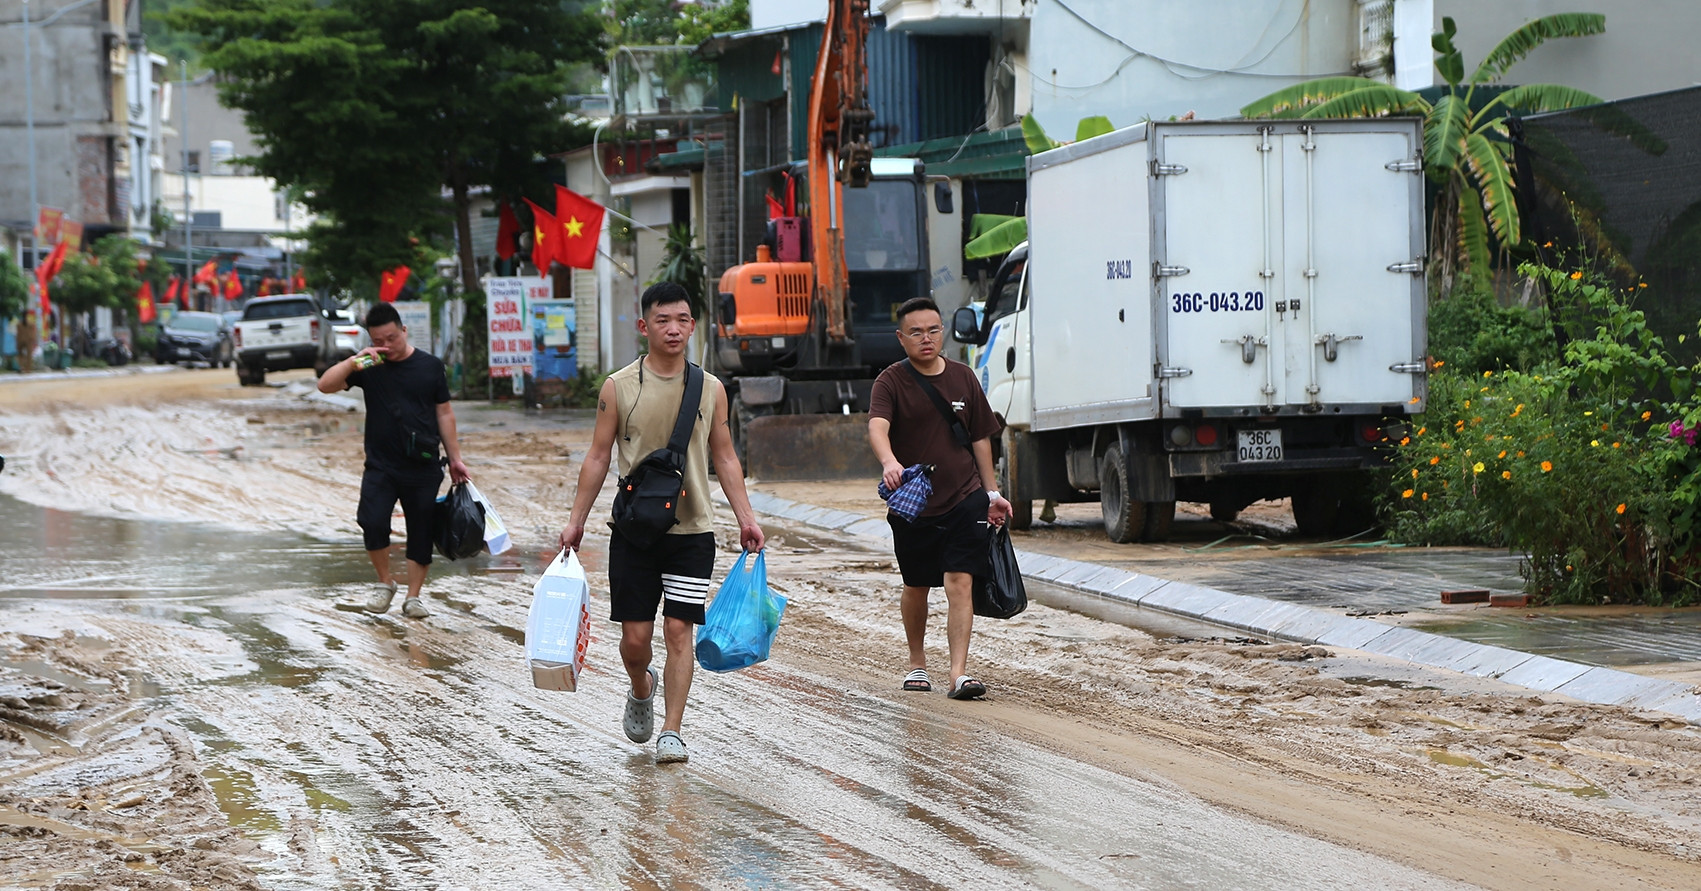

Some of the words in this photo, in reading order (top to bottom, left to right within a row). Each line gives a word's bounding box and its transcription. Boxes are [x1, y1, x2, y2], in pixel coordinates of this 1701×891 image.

[494, 297, 518, 315] SỬA
[1172, 291, 1264, 313] 36C-043.20
[491, 317, 523, 332] CHỮA
[1249, 431, 1271, 445] 36C
